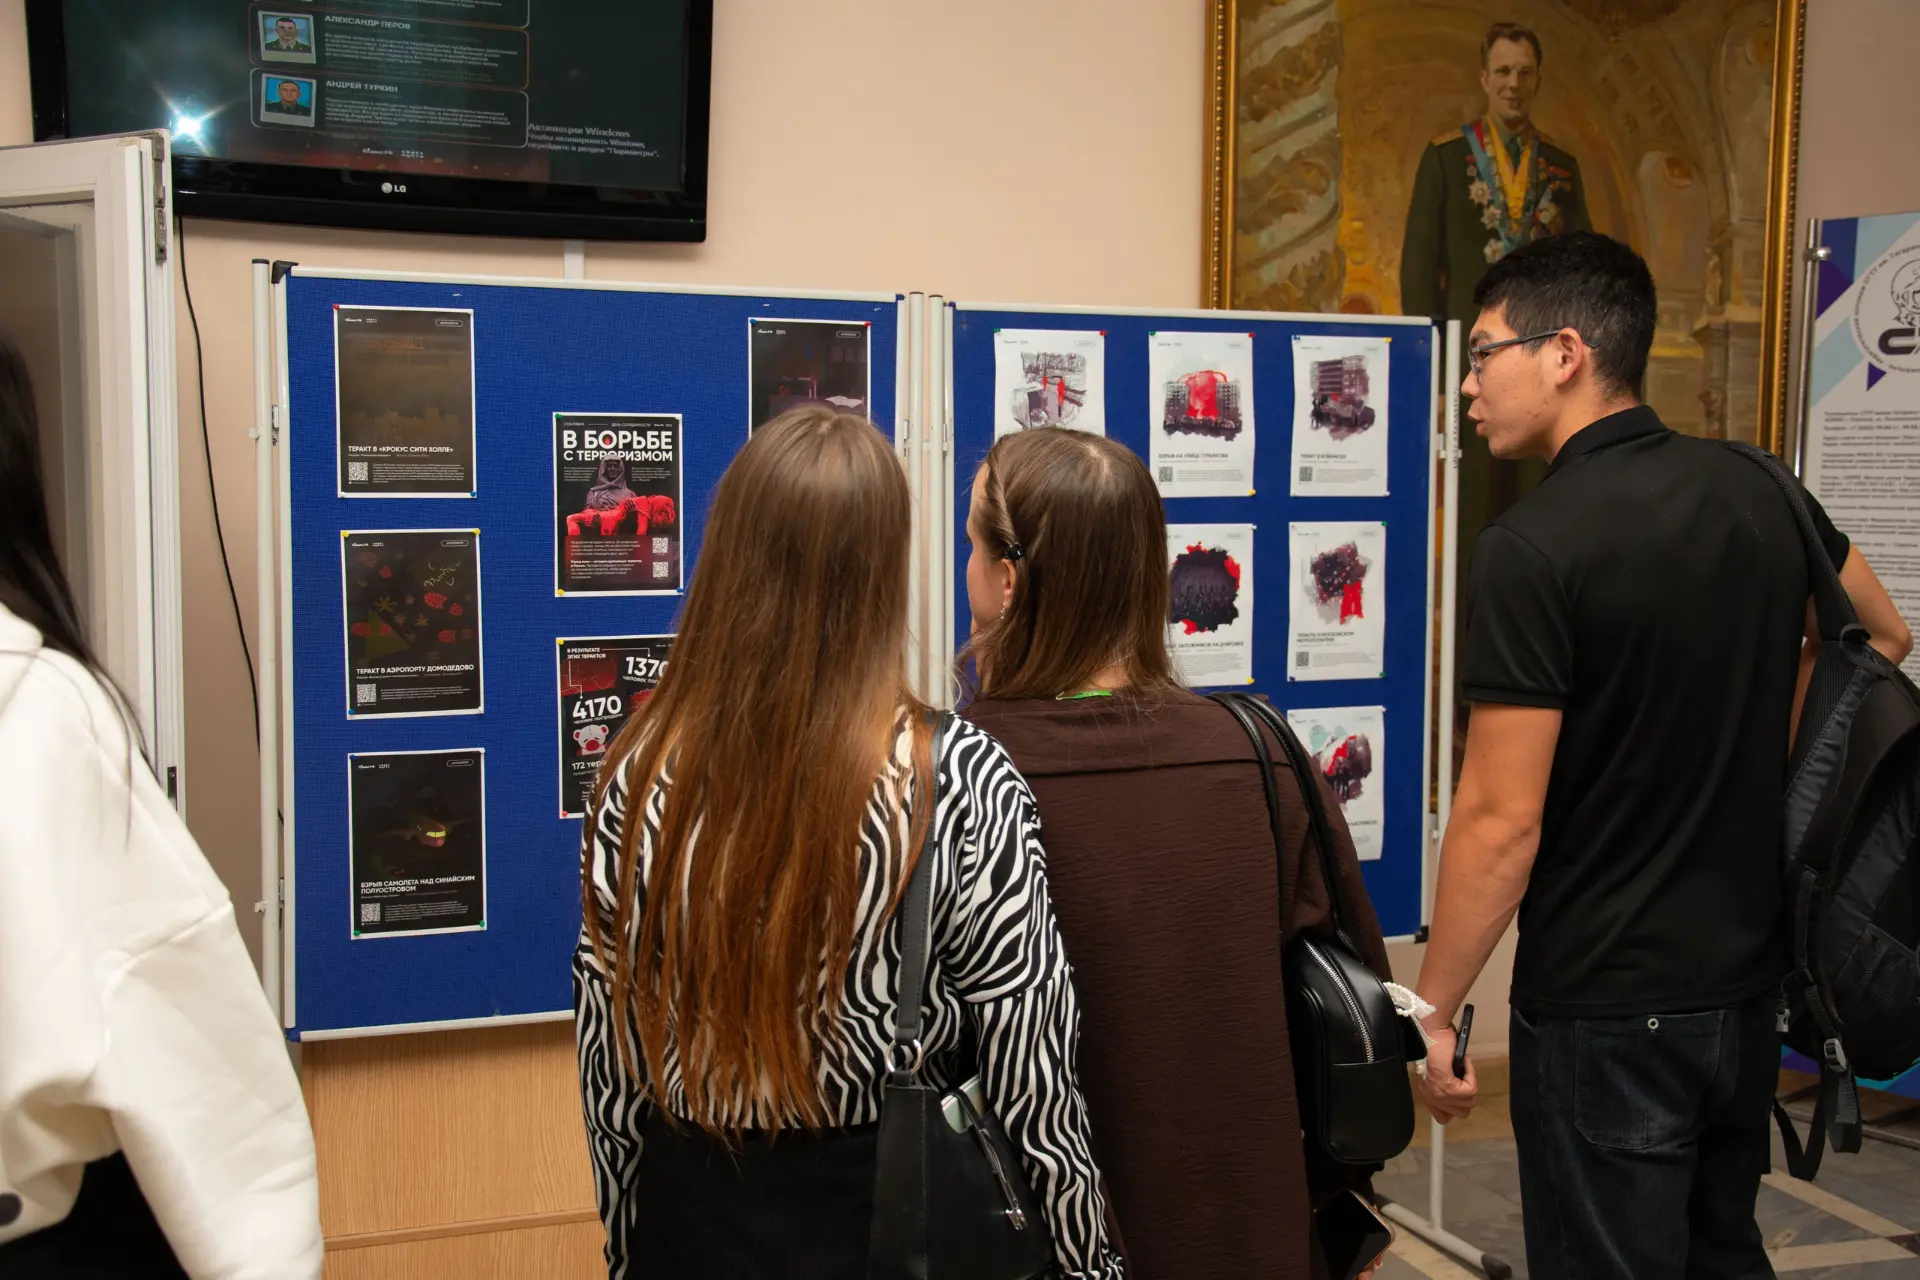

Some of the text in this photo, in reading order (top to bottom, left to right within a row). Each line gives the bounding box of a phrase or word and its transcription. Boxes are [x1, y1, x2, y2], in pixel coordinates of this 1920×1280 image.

[324, 14, 411, 30] АЛЕКСАНДР ПЕРОВ
[325, 79, 398, 93] АНДРЕЙ ТУРКИН
[585, 126, 631, 138] Windows
[394, 184, 407, 193] LG
[563, 430, 673, 450] В БОРЬБЕ
[563, 451, 573, 461] С
[427, 664, 475, 673] ДОМОДЕДОВО
[572, 695, 622, 719] 4170
[572, 761, 586, 771] 172
[383, 879, 419, 887] САМОЛЕТА
[435, 875, 475, 884] СИНАЙСКИМ
[361, 886, 416, 894] ПОЛУОСТРОВОМ
